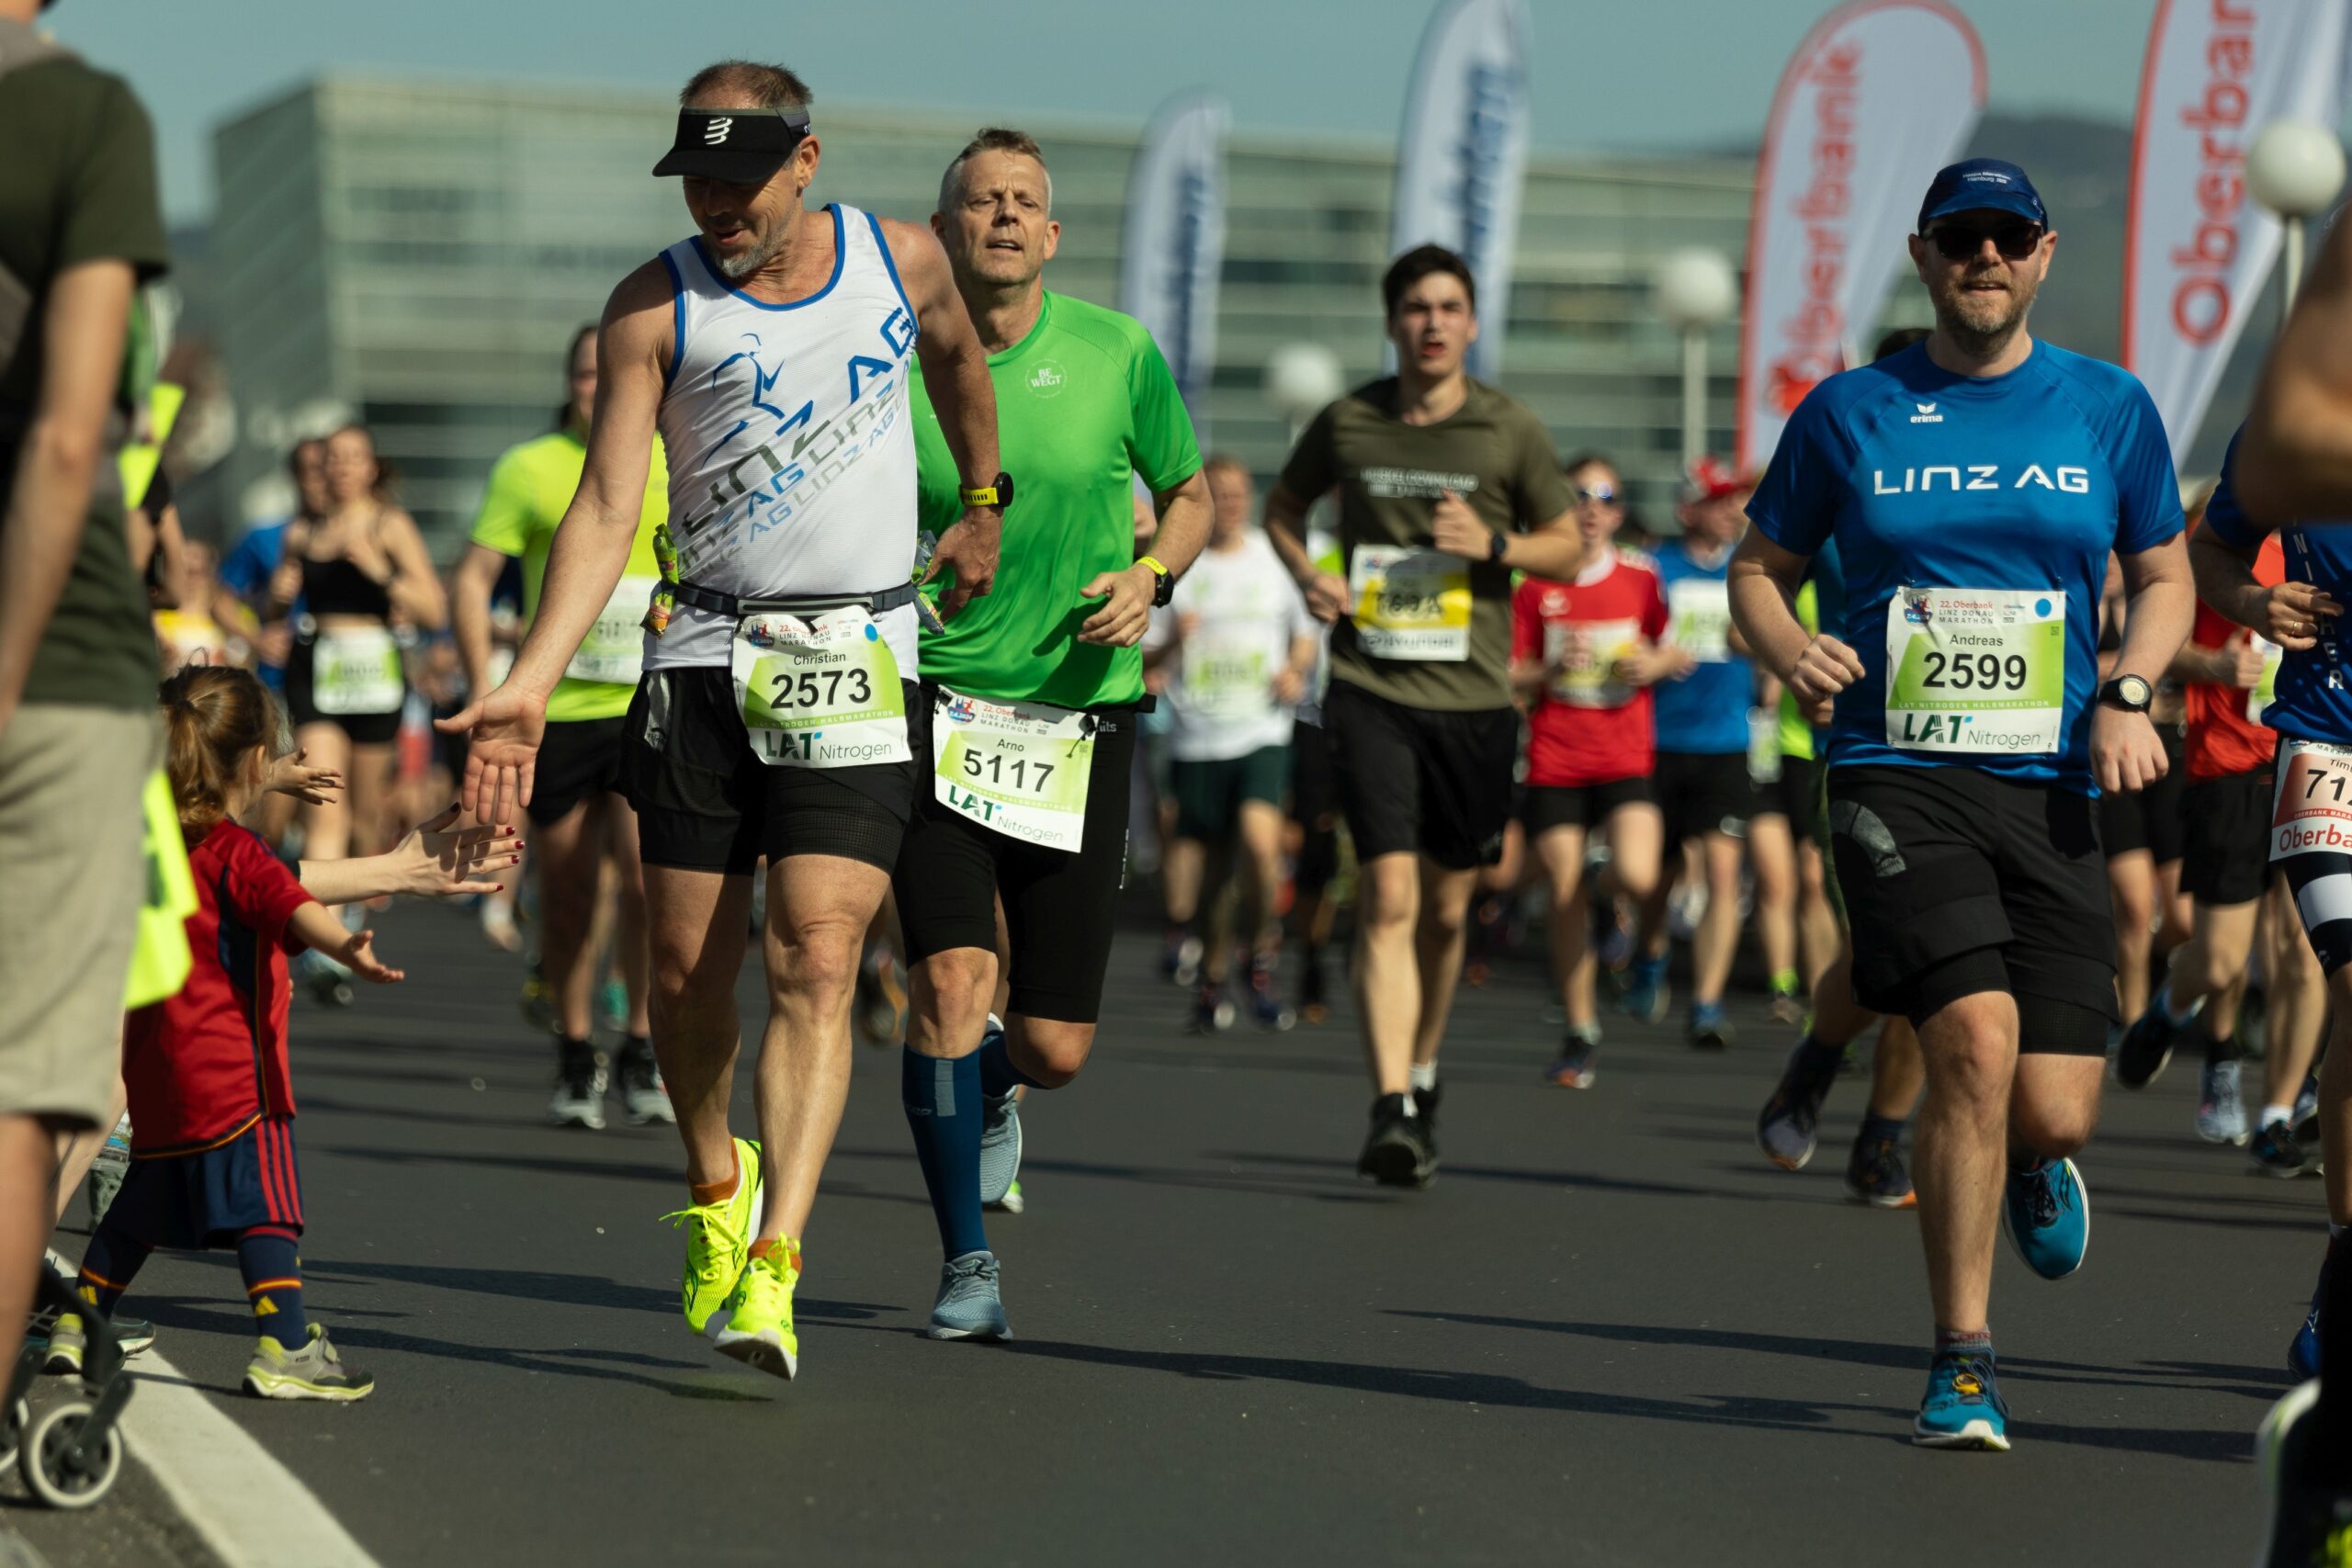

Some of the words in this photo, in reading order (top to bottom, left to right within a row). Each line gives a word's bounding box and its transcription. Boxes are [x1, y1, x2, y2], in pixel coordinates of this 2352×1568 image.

[1030, 374, 1062, 388] WEGT
[1910, 413, 1944, 423] erima
[1874, 466, 1999, 495] LINZ
[2014, 465, 2089, 494] AG
[1953, 600, 1994, 610] Oberbank
[1939, 616, 1994, 625] MARATHON
[1962, 609, 1994, 617] DONAU
[1949, 634, 2004, 647] Andreas
[793, 652, 846, 666] Christian
[1922, 651, 2027, 691] 2599
[770, 668, 872, 710] 2573
[980, 718, 1029, 733] MARATHON
[1903, 713, 1963, 744] LAT
[1967, 730, 2041, 750] Nitrogen
[764, 731, 814, 761] LAT
[819, 743, 892, 761] Nitrogen
[997, 739, 1024, 751] Arno
[963, 748, 1055, 793] 5117
[2305, 768, 2352, 807] 71
[948, 784, 994, 821] LAT
[997, 816, 1064, 843] Nitrogen
